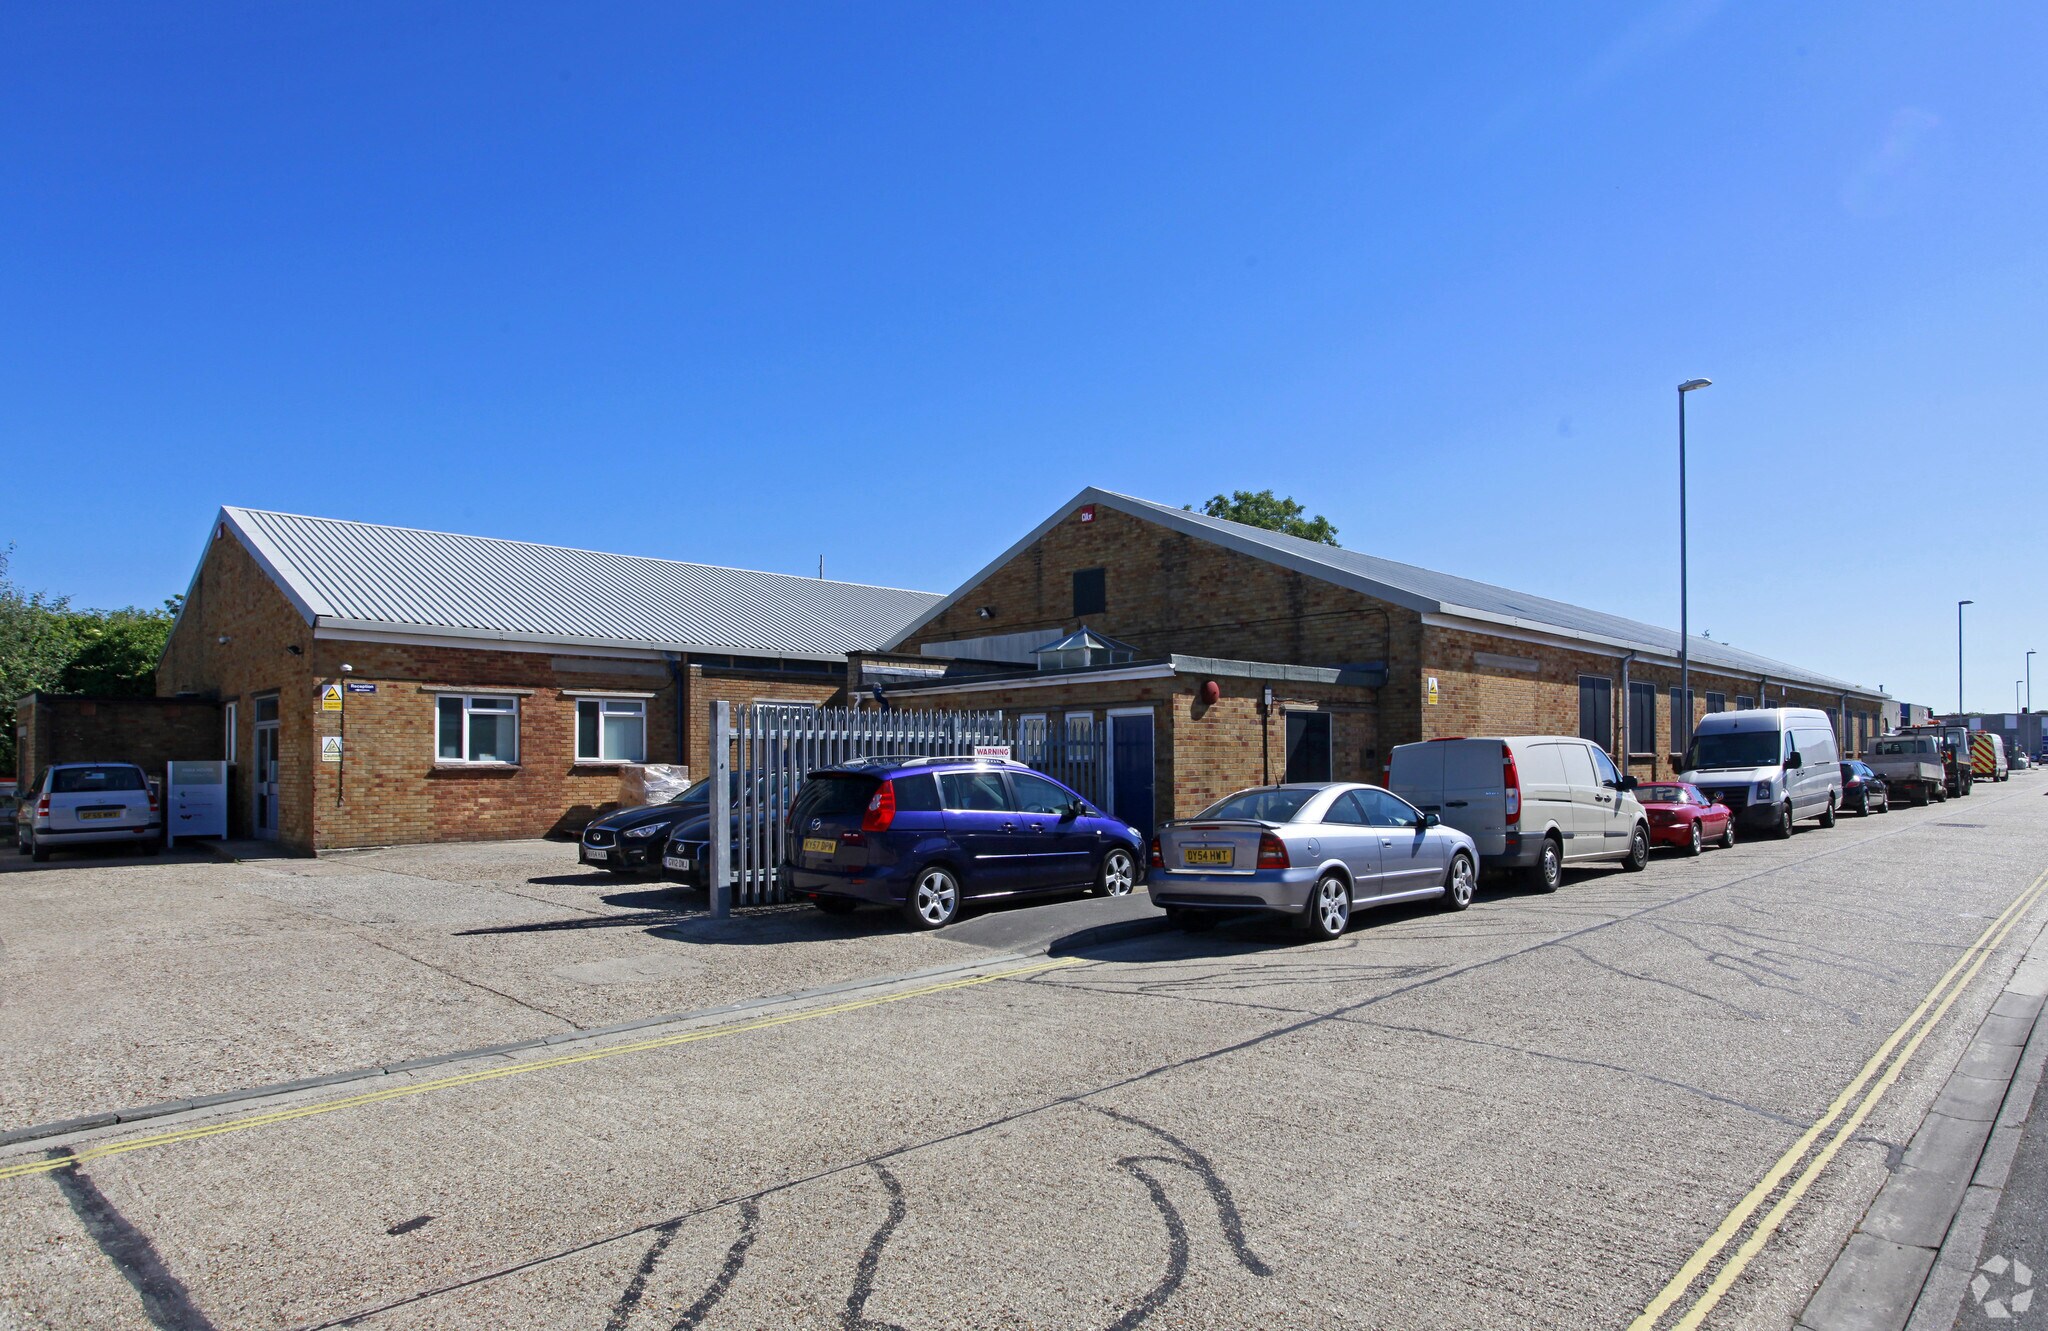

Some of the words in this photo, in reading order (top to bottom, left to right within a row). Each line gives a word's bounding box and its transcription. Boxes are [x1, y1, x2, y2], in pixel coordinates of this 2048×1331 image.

[976, 748, 1009, 756] WARNING
[1187, 850, 1208, 861] DY54
[1209, 850, 1228, 861] HWT
